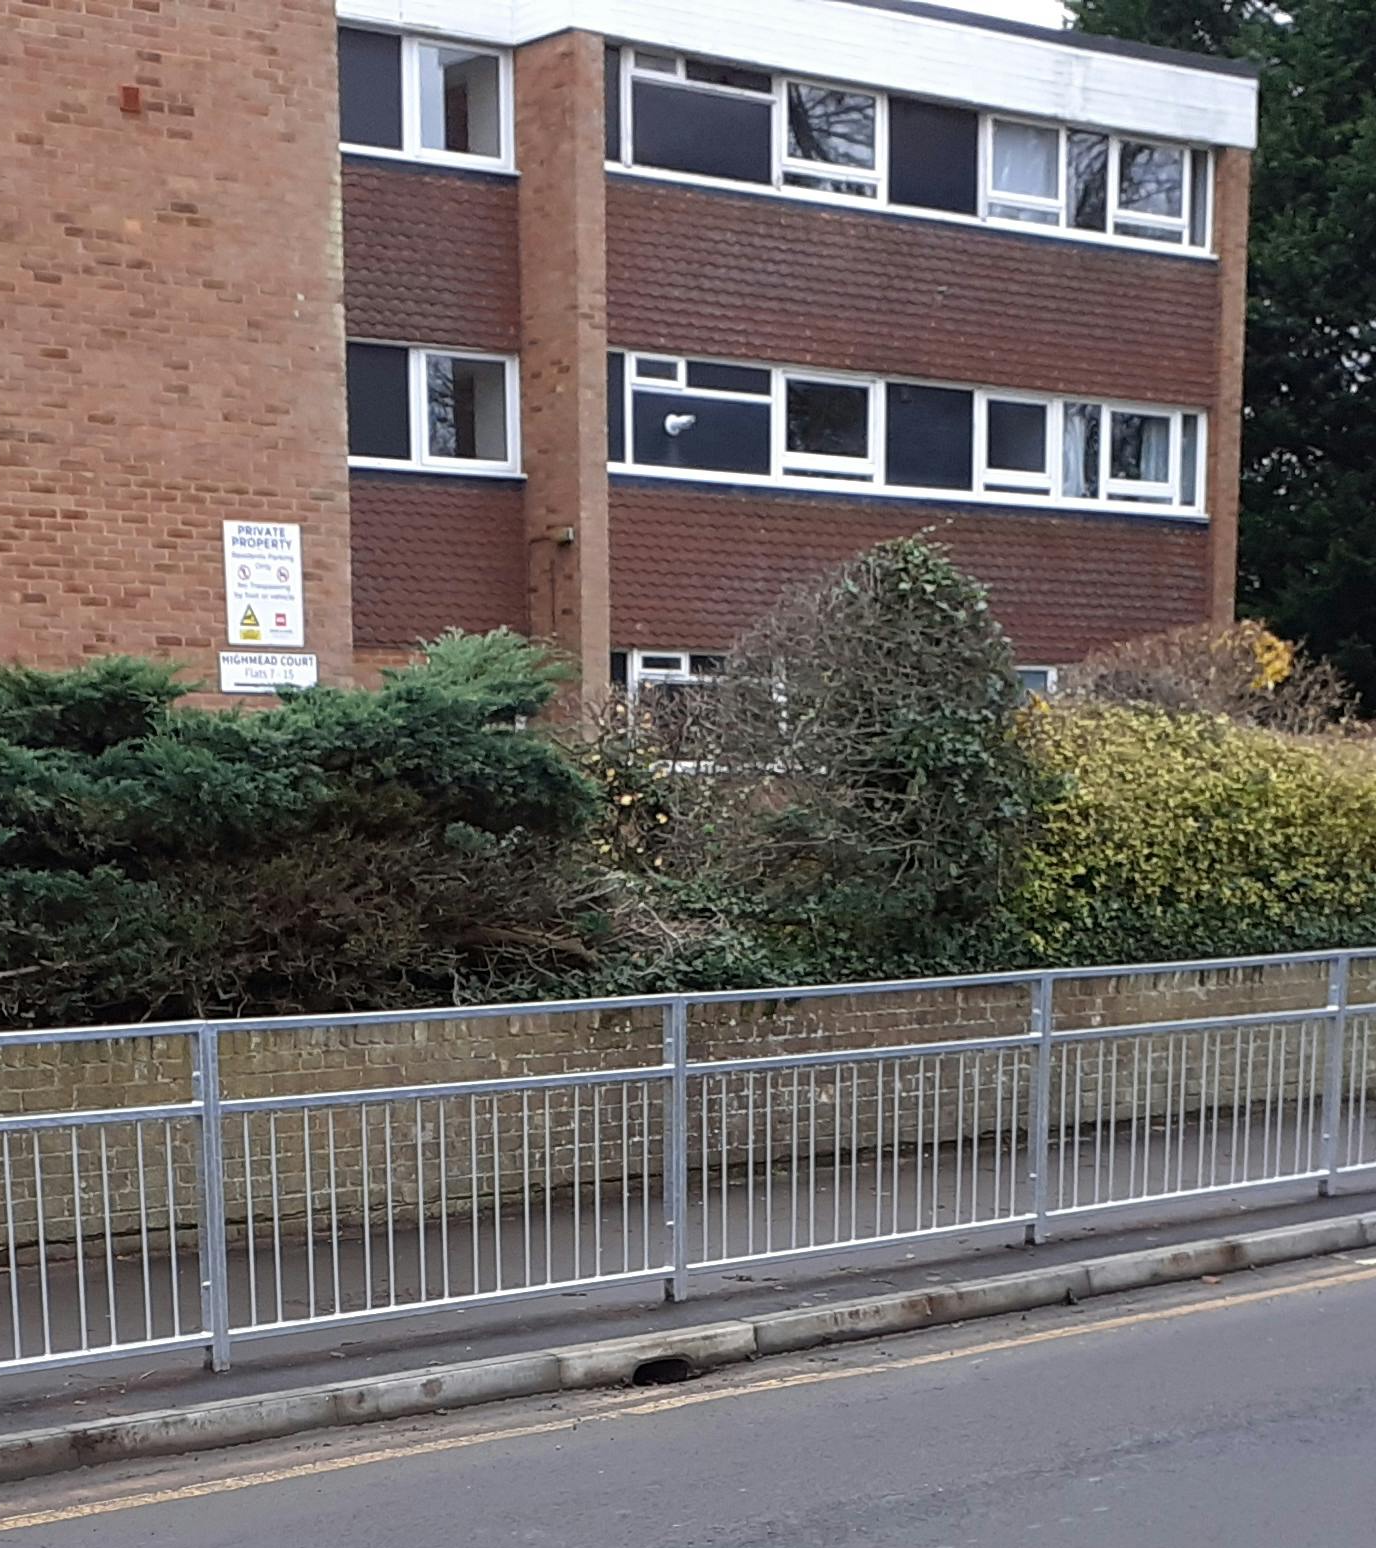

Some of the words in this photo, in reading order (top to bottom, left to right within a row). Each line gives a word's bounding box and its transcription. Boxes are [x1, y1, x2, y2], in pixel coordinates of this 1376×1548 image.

[238, 525, 285, 537] PRIVATE
[231, 537, 292, 550] PROPERTY
[280, 656, 314, 666] COURT
[245, 667, 268, 679] Flats
[270, 669, 275, 679] 7
[284, 669, 295, 680] 15
